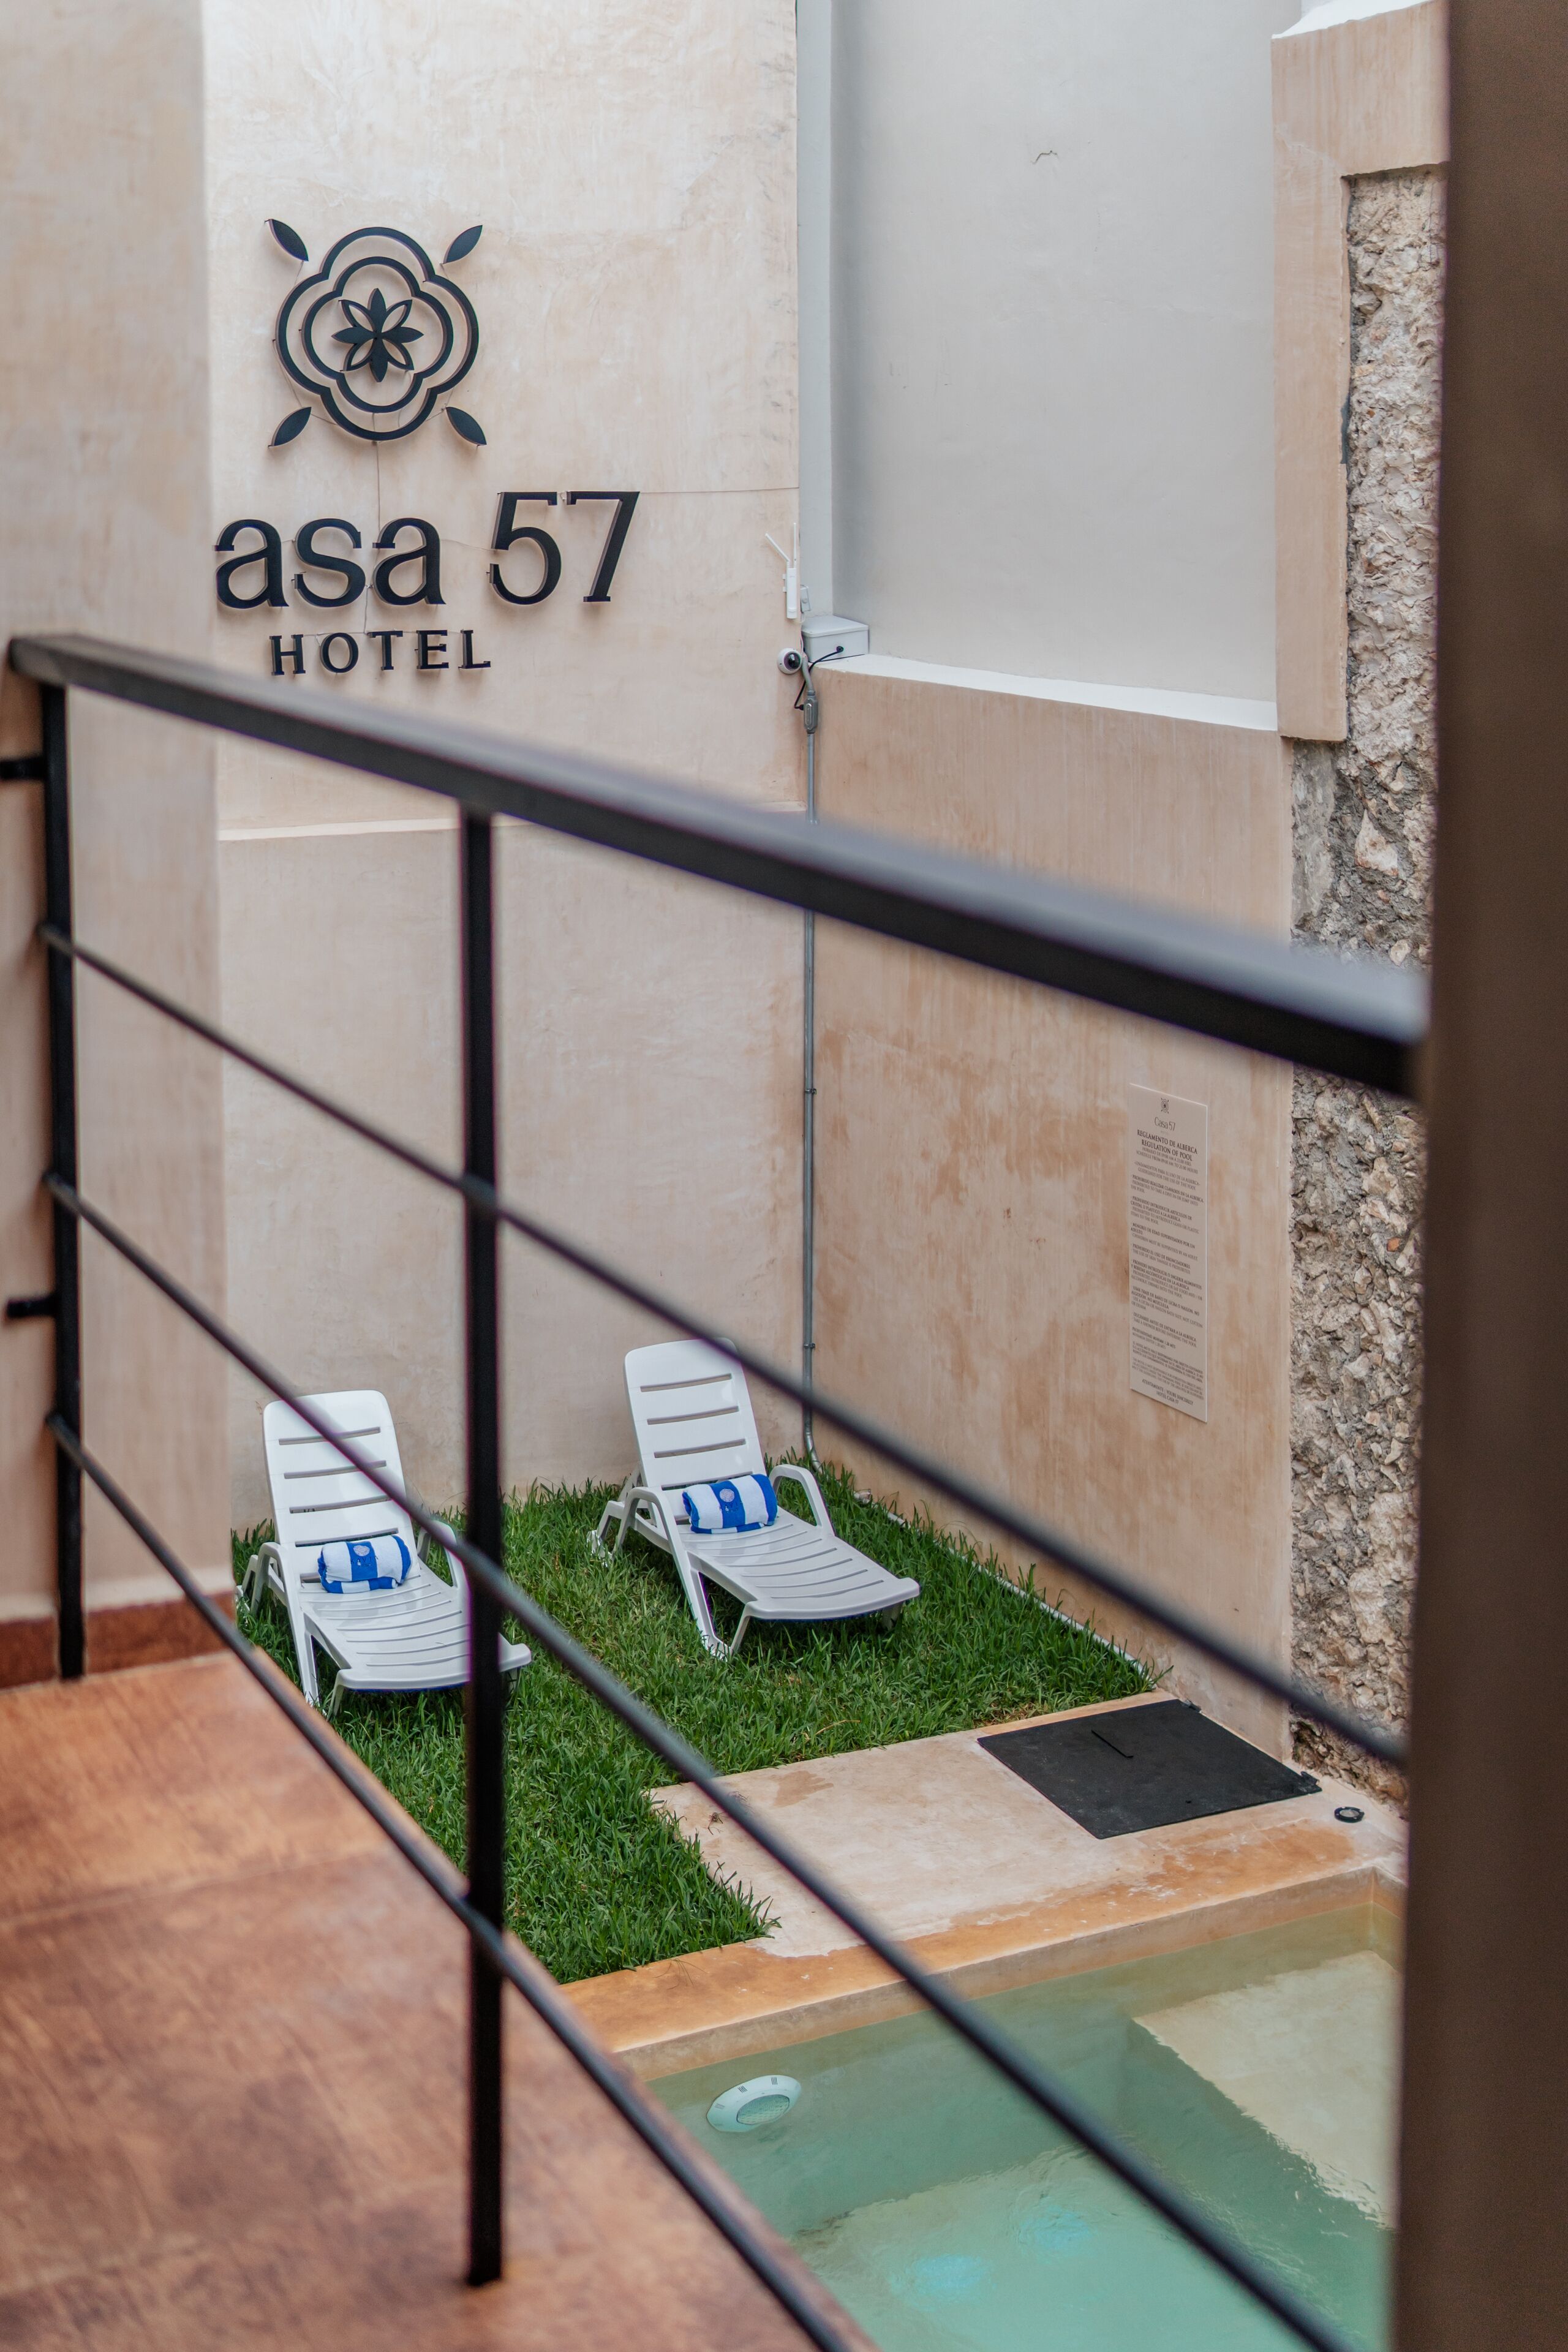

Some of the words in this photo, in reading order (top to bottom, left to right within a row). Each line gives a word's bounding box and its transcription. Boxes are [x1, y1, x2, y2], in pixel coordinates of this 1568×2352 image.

[489, 491, 641, 605] 57
[269, 630, 491, 676] HOTEL
[1154, 1116, 1167, 1129] Casa
[1169, 1121, 1176, 1132] 57
[1137, 1129, 1168, 1145] REGLAMENTO
[1177, 1142, 1197, 1155] ALBERCA
[1142, 1139, 1171, 1154] REGULATION
[1180, 1152, 1193, 1161] POOL
